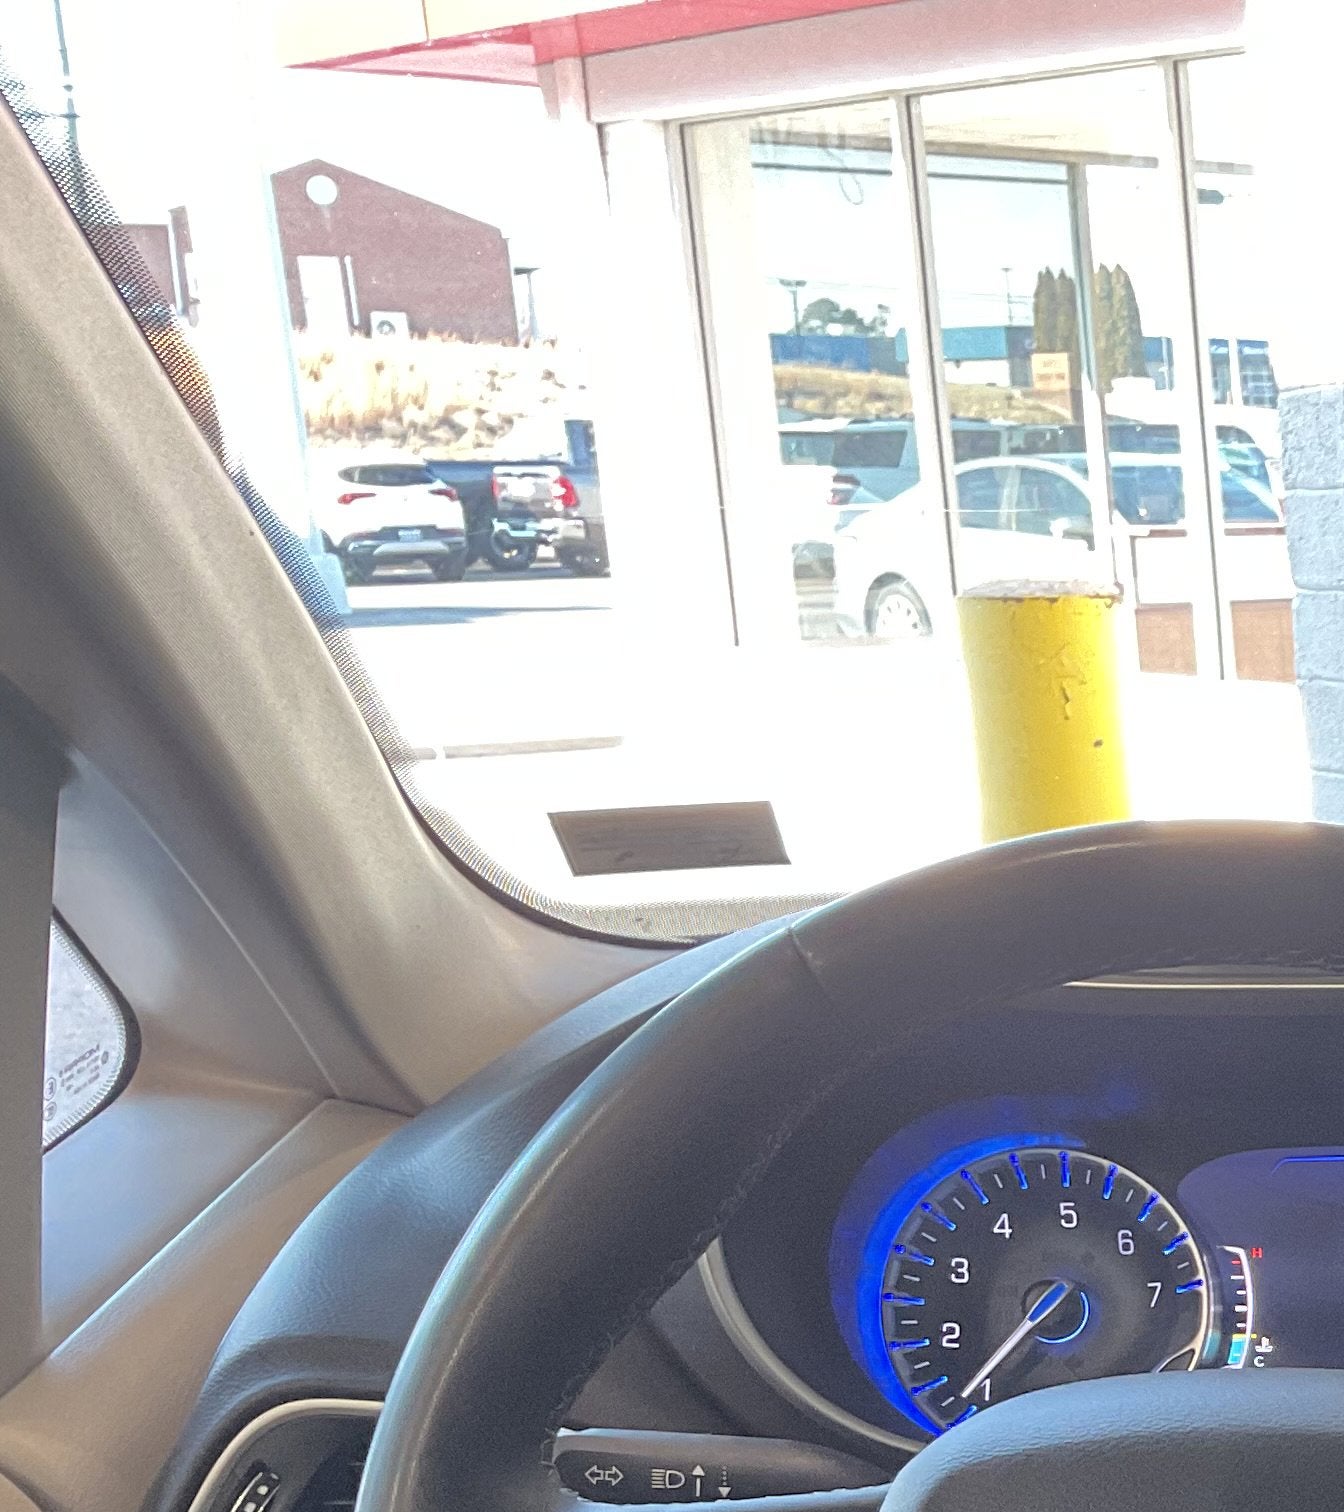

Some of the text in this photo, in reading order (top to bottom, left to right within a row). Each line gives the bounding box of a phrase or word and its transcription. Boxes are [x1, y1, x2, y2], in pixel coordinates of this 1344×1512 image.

[993, 1212, 1013, 1239] 4
[1060, 1202, 1078, 1229] 5
[1117, 1229, 1135, 1256] 6
[1251, 1247, 1264, 1259] H
[950, 1257, 970, 1284] 3
[1146, 1282, 1162, 1309] 7
[941, 1321, 961, 1349] 2
[980, 1378, 992, 1401] 1
